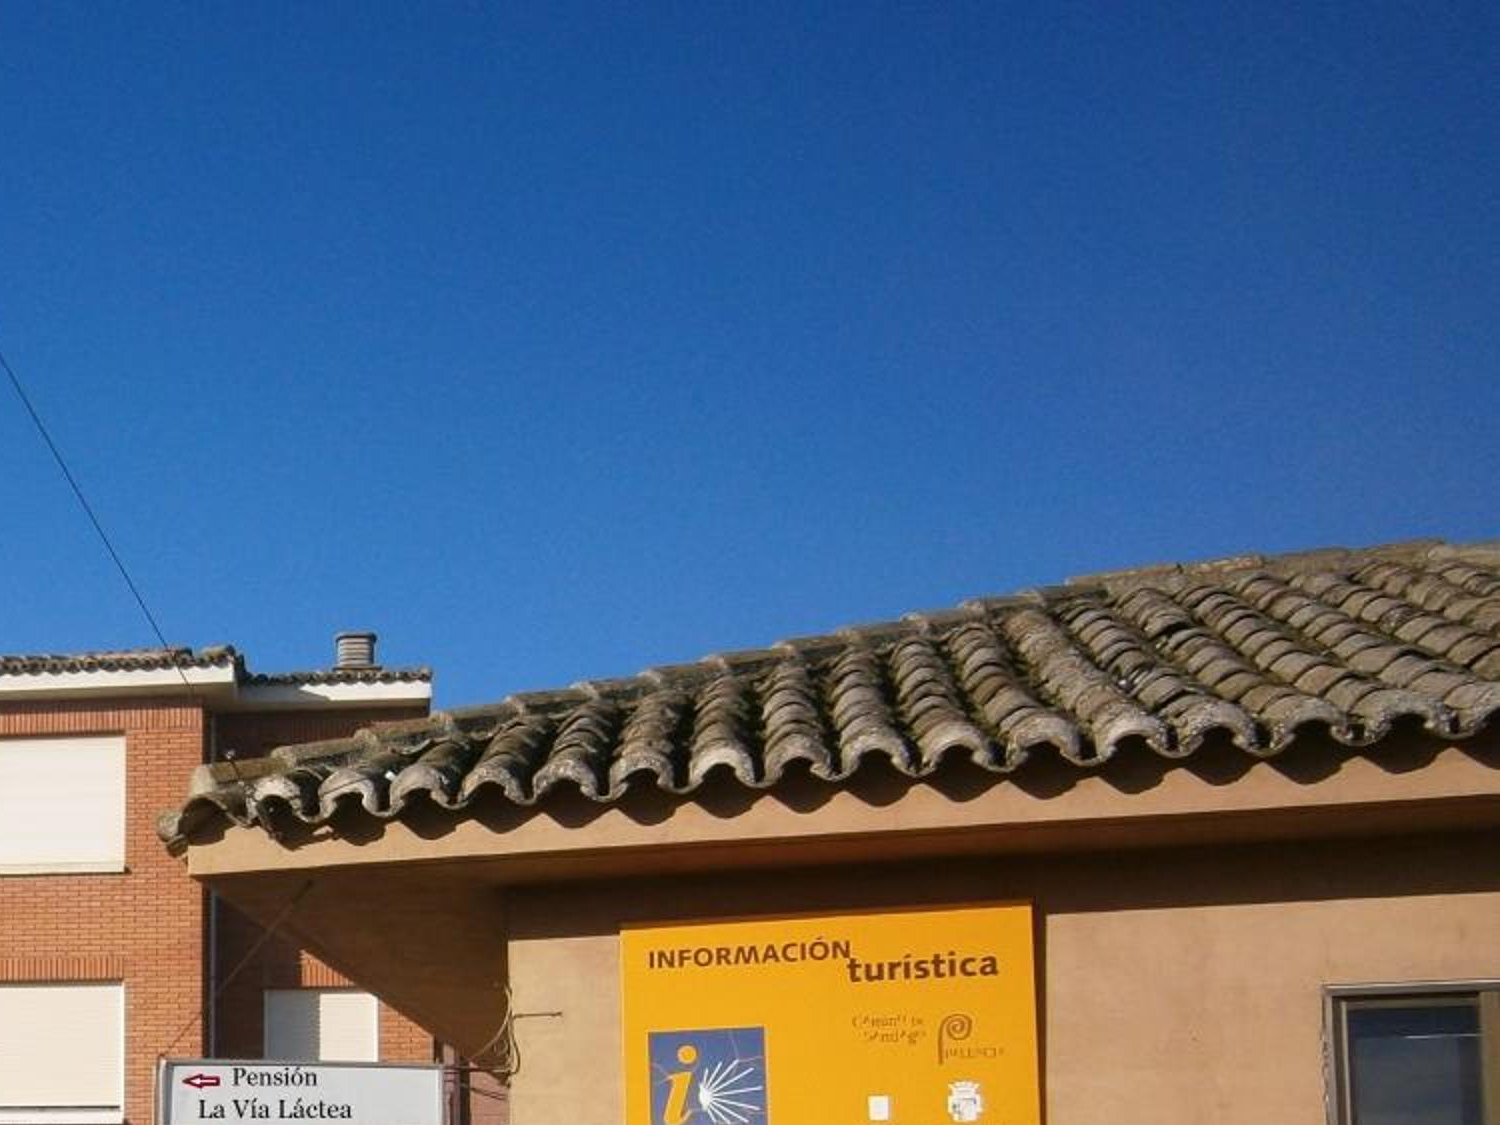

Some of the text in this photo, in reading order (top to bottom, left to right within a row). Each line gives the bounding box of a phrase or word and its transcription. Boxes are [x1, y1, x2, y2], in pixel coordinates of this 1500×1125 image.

[649, 937, 998, 982] INFORMACIÓN turística
[232, 1067, 317, 1086] Pensión
[199, 1098, 352, 1119] La Vía Láctea
